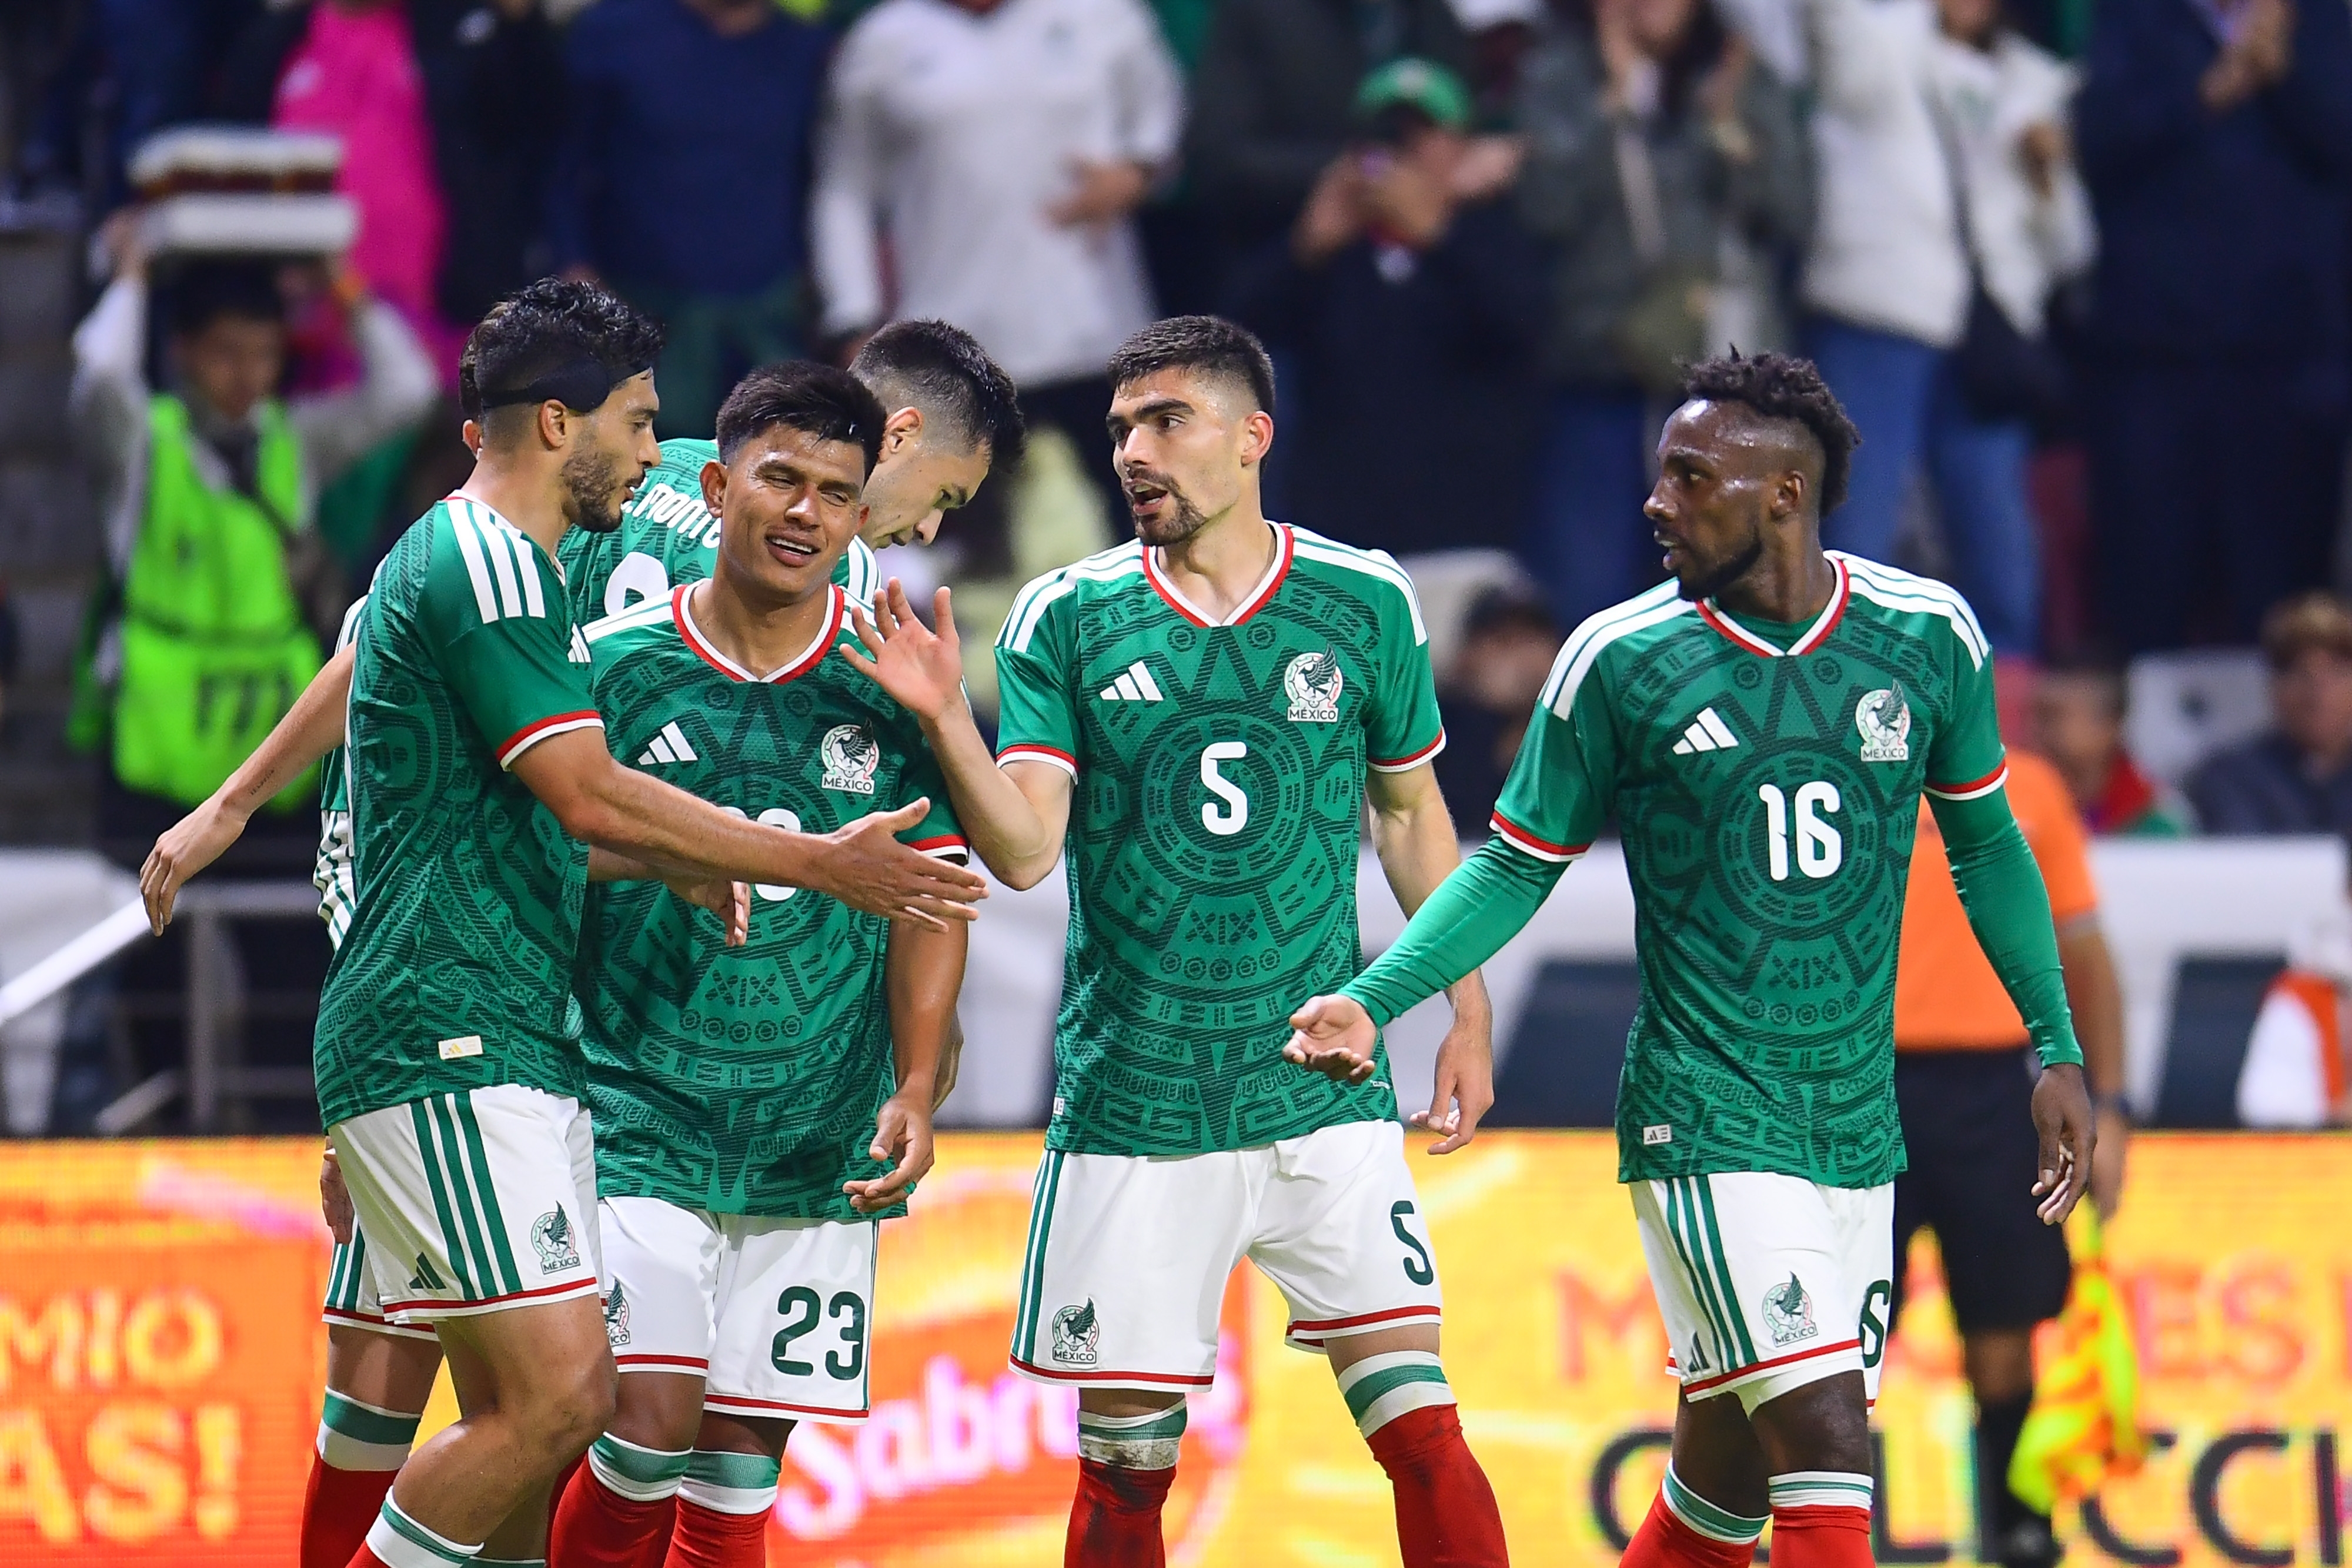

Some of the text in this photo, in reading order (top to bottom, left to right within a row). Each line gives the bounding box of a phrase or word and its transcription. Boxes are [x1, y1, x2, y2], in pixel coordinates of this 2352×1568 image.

[1289, 707, 1336, 720] MÉXICO
[824, 775, 872, 791] MÉXICO
[1201, 741, 1247, 835] 5
[1759, 781, 1842, 881] 16
[1391, 1201, 1434, 1285] 5
[771, 1286, 865, 1380] 23
[1054, 1350, 1094, 1361] MÉXICO
